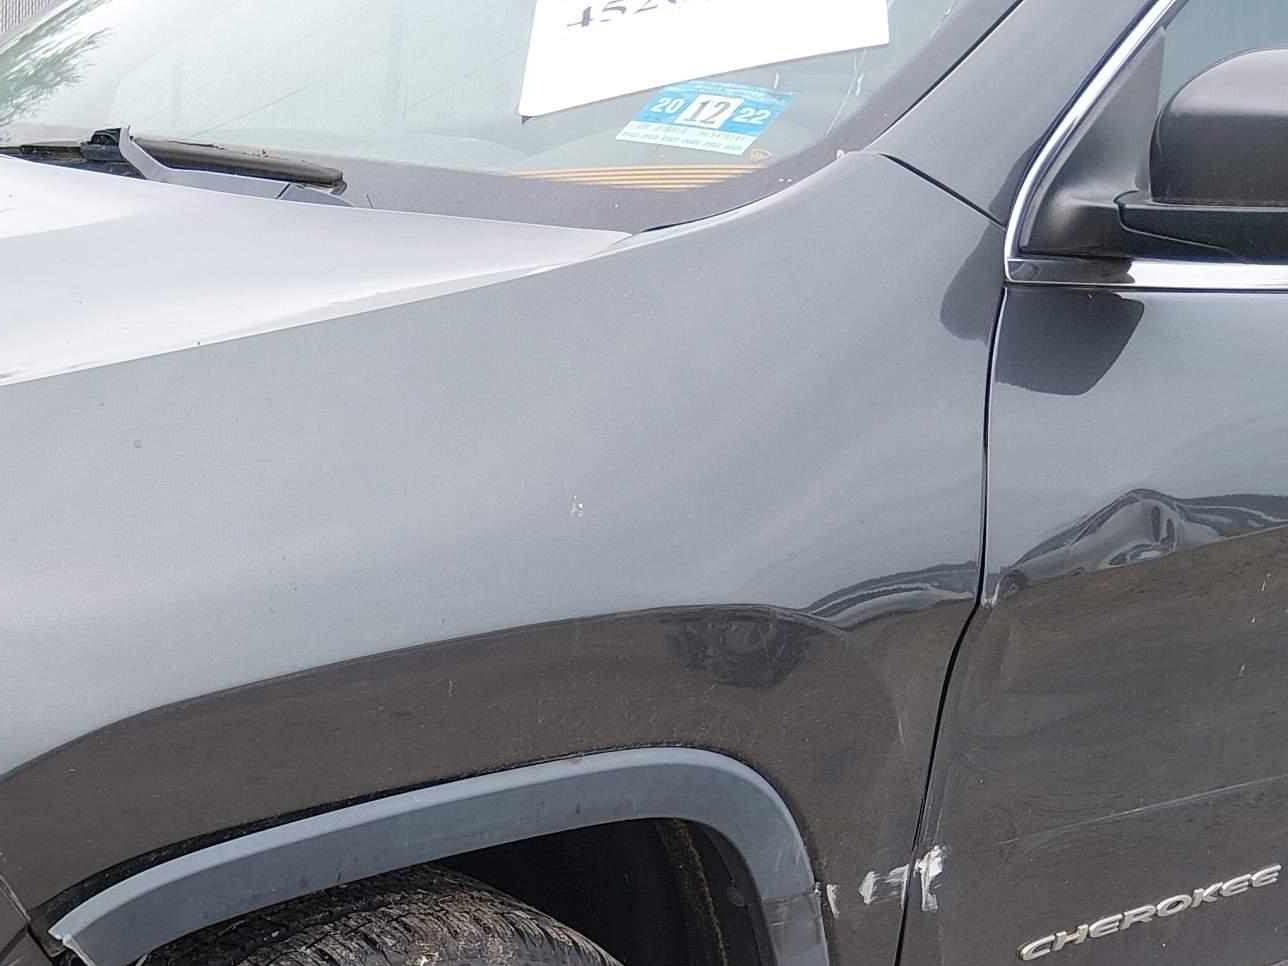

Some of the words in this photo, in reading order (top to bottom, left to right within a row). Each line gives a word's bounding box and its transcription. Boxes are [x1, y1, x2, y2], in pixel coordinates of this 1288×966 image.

[650, 97, 685, 114] 20
[684, 99, 731, 124] 12
[732, 107, 772, 125] 22
[1018, 863, 1282, 961] CHEROKEE
